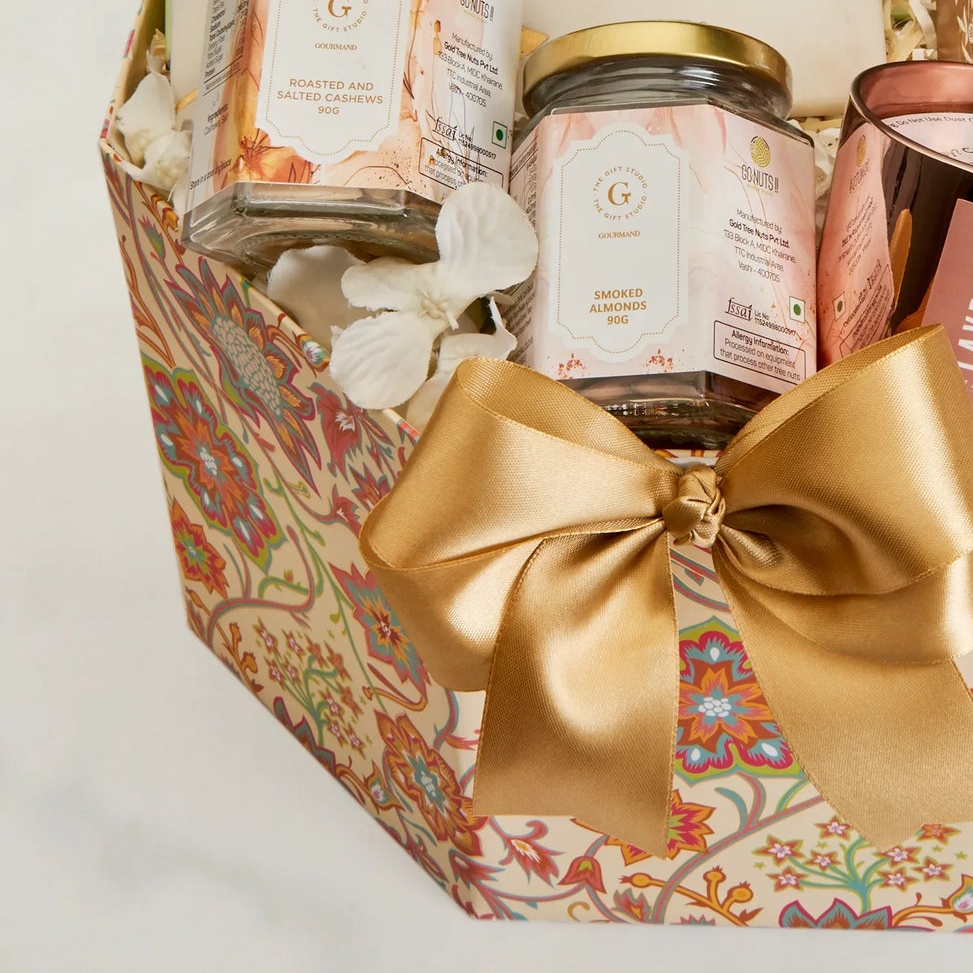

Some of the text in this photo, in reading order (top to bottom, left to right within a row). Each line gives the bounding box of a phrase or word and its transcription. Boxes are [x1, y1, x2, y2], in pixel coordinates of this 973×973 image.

[312, 7, 368, 33] THE GIFT STUDIO
[314, 42, 358, 52] GOURMAND
[444, 41, 456, 53] Gold
[455, 47, 467, 59] Tree
[466, 53, 479, 66] Nuts
[479, 59, 489, 71] Pvt
[289, 78, 374, 91] ROASTED AND
[276, 90, 384, 104] SALTED CASHEWS
[317, 106, 340, 115] 90G
[593, 166, 648, 192] THE GIFT STUDIO
[607, 181, 631, 206] G
[592, 195, 647, 221] THE GIFT STUDIO
[736, 208, 774, 230] Manufactured
[598, 230, 641, 240] GOURMAND
[729, 218, 742, 231] Gold
[742, 223, 755, 235] Tree
[754, 228, 769, 241] Nuts
[768, 233, 779, 245] Pvt
[734, 233, 750, 245] Block
[756, 242, 771, 254] MIDC
[734, 245, 746, 257] TTC
[746, 251, 770, 267] Industrial
[594, 288, 643, 300] SMOKED
[589, 301, 647, 314] ALMONDS
[725, 297, 753, 321] fssai
[607, 315, 629, 325] 90G
[724, 337, 796, 369] Processed on equipment
[731, 330, 790, 356] Allergy Information:
[720, 347, 801, 381] that process other tree nuts
